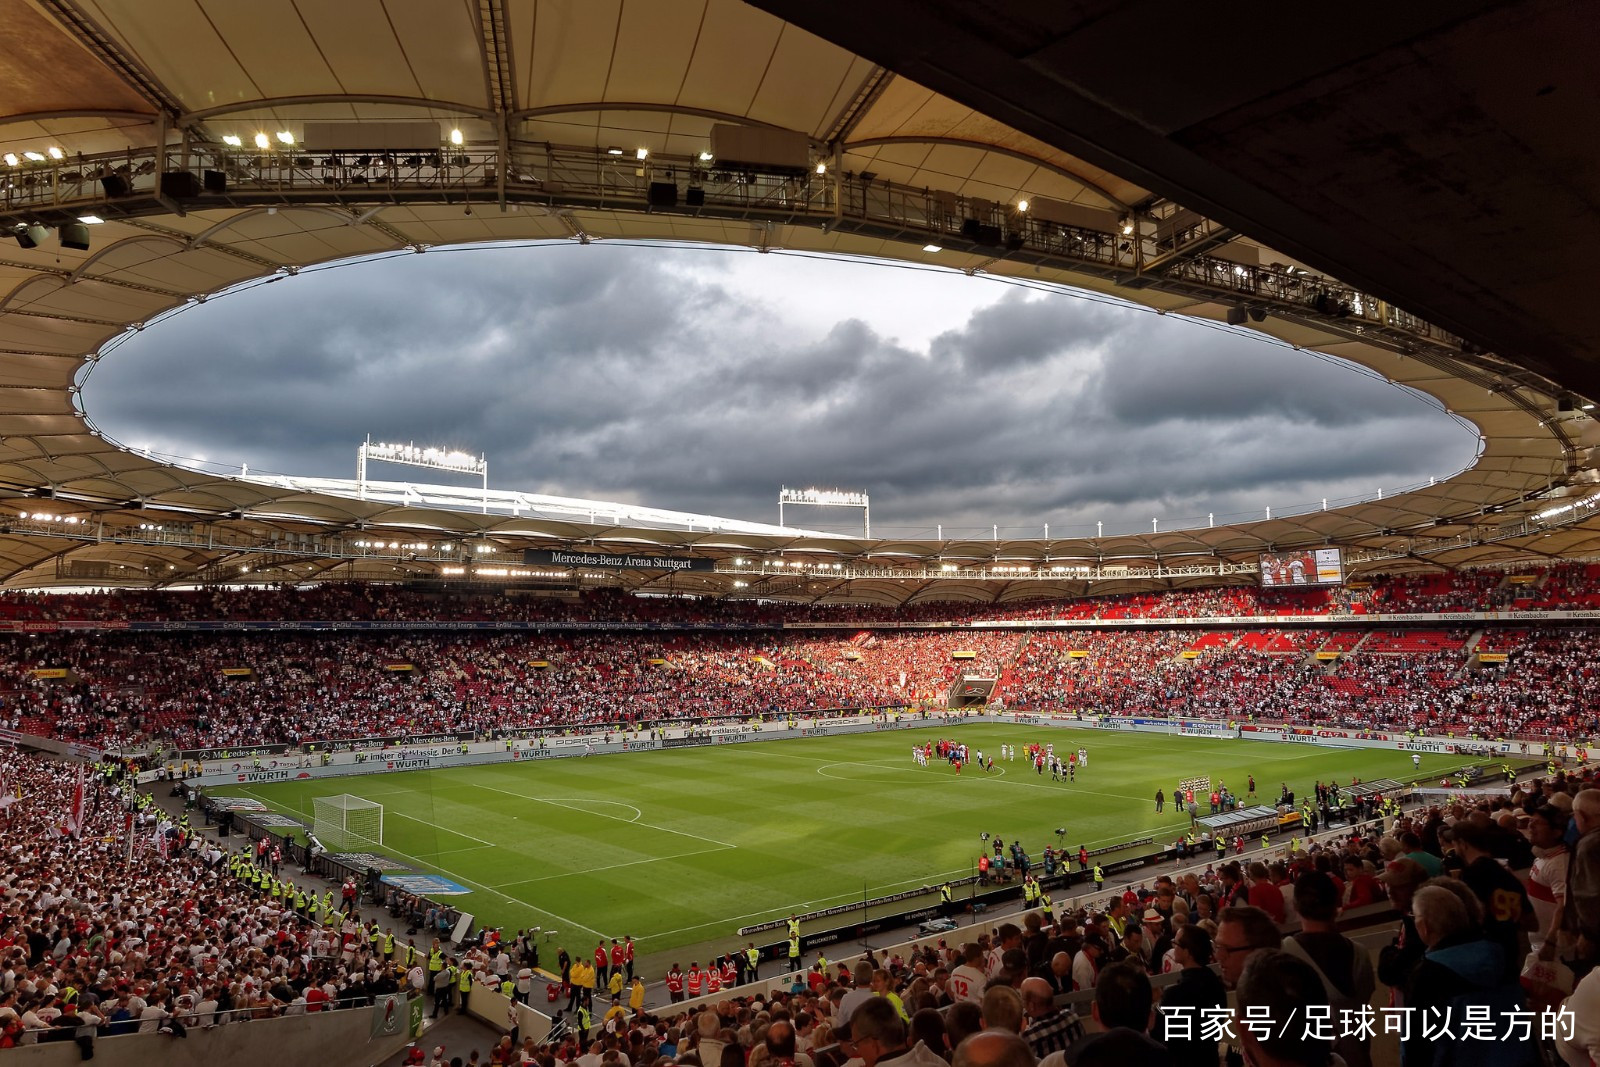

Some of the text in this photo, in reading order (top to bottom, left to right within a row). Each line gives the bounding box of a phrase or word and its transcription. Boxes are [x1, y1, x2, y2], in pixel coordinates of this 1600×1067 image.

[552, 551, 692, 570] Mercedes-Benz Arena Stuttgart
[629, 741, 655, 750] WÜRTH
[1406, 743, 1440, 752] WÜRTH
[442, 747, 455, 755] Der
[521, 749, 551, 759] WÜRTH
[395, 759, 430, 769] WÜRTH
[248, 770, 288, 781] WÜRTH
[954, 979, 968, 997] 12
